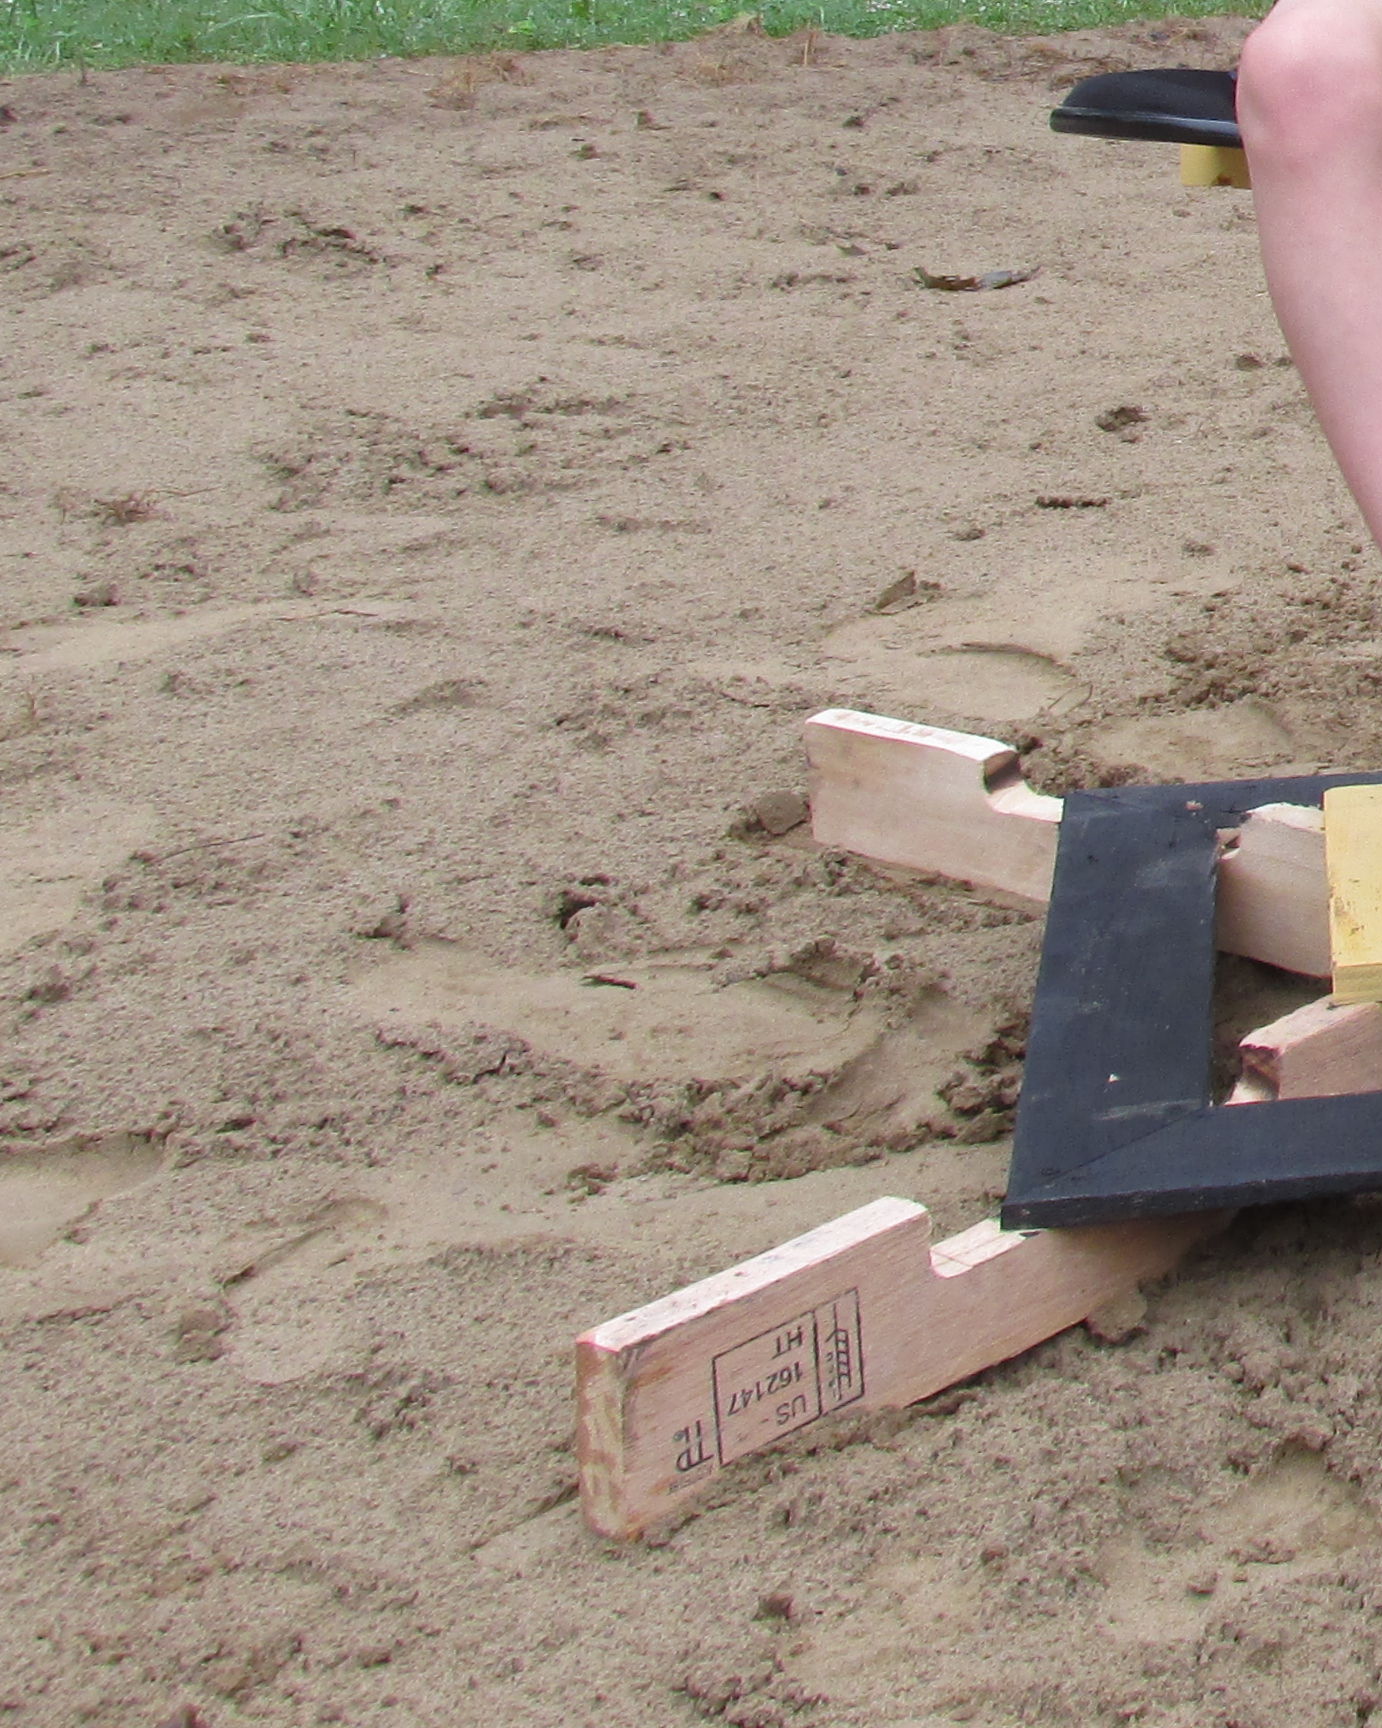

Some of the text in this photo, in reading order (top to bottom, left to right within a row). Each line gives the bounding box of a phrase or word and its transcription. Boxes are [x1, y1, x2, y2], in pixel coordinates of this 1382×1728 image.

[771, 1325, 803, 1360] HT
[727, 1361, 803, 1417] 162147
[776, 1394, 807, 1425] US
